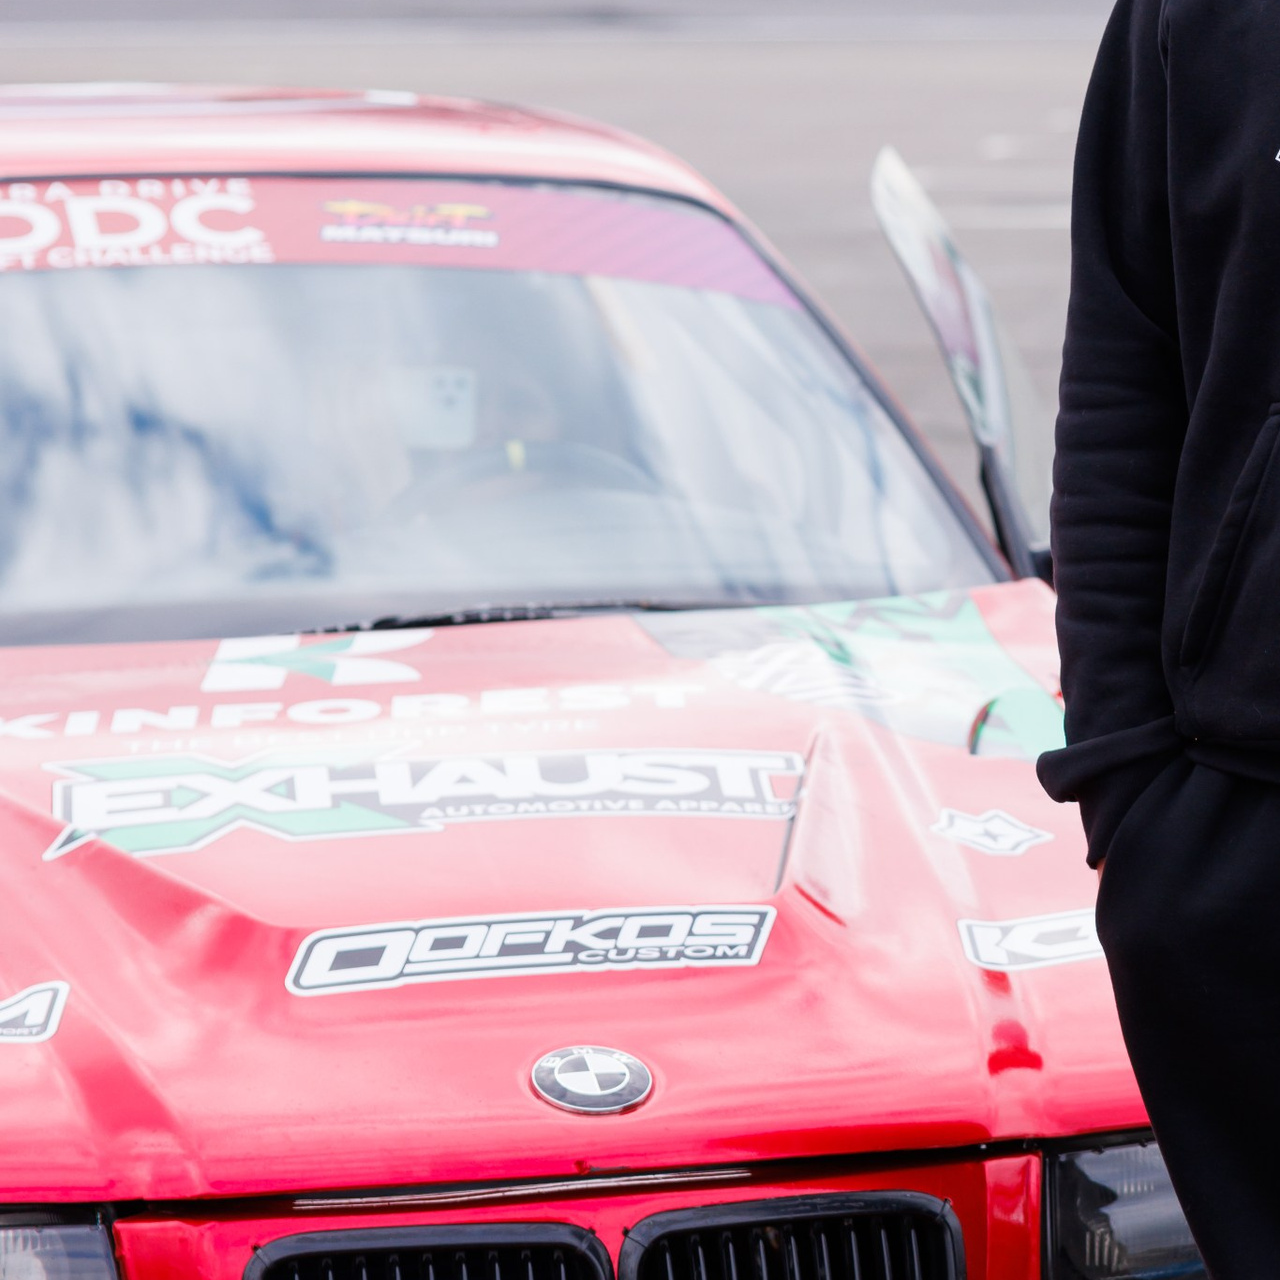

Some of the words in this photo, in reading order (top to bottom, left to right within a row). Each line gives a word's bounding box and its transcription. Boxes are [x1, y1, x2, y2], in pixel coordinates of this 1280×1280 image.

[66, 751, 791, 835] EXHAUST
[418, 798, 645, 820] AUTOMOTIVE
[576, 944, 750, 962] CUSTOM
